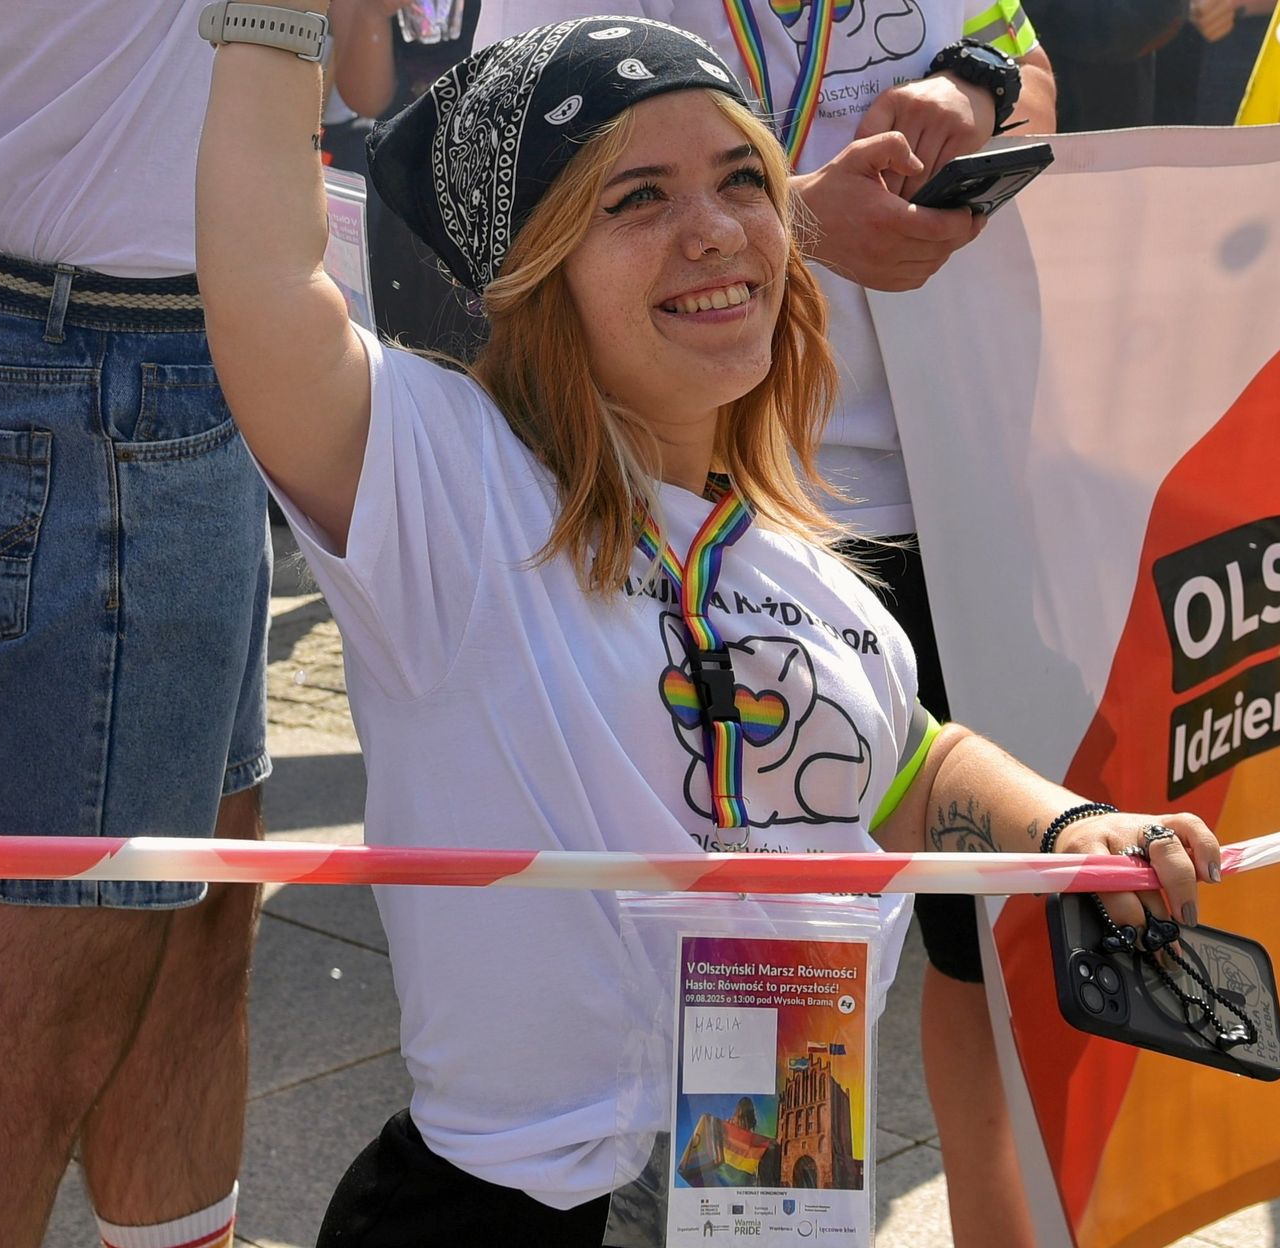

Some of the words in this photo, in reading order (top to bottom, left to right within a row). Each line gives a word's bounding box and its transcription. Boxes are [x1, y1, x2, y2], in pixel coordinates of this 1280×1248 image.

[687, 962, 695, 974] V
[697, 962, 755, 977] Olsztyński
[758, 963, 794, 977] Marsz
[798, 964, 857, 979] Równości
[685, 979, 716, 990] Hasło:
[718, 980, 763, 992] Równość
[766, 982, 777, 992] to
[779, 981, 840, 995] przyszłość!
[685, 994, 725, 1003] 09.08.2025
[733, 995, 755, 1004] 13:00
[756, 996, 772, 1005] pod
[773, 996, 805, 1007] Wysoką
[807, 998, 833, 1008] Bramą
[695, 1016, 741, 1033] MARIA
[691, 1046, 740, 1063] WNUK
[734, 1218, 761, 1226] Warmia
[734, 1226, 761, 1235] PRIDE
